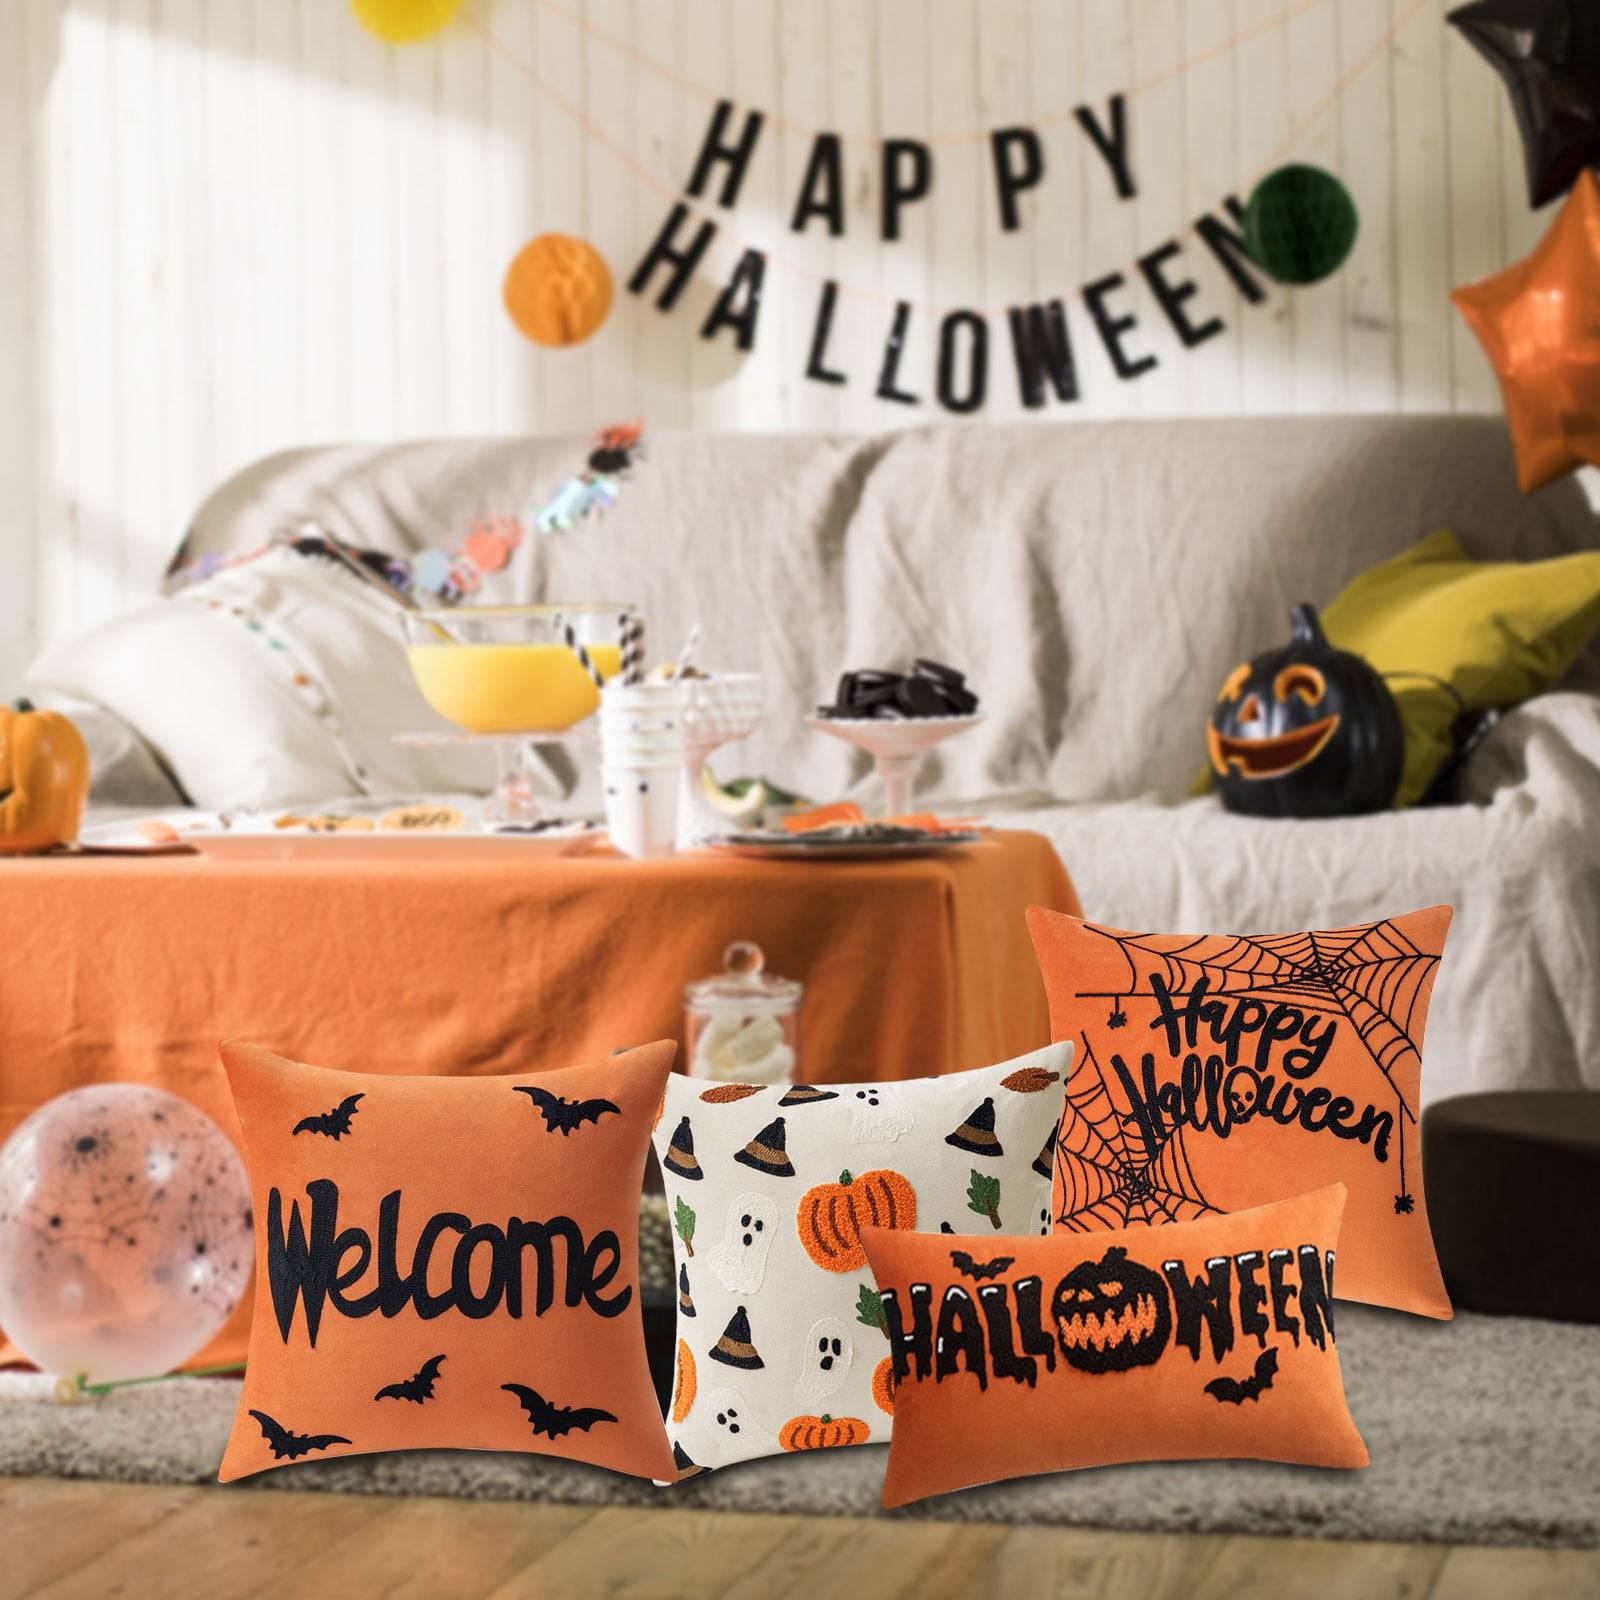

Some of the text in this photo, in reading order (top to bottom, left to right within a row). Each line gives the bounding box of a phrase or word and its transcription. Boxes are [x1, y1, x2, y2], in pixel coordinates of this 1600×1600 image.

[687, 93, 1137, 241] HAPPY
[1149, 973, 1338, 1080] Happy
[1110, 1053, 1394, 1163] Halloween
[267, 1178, 632, 1348] Welcome
